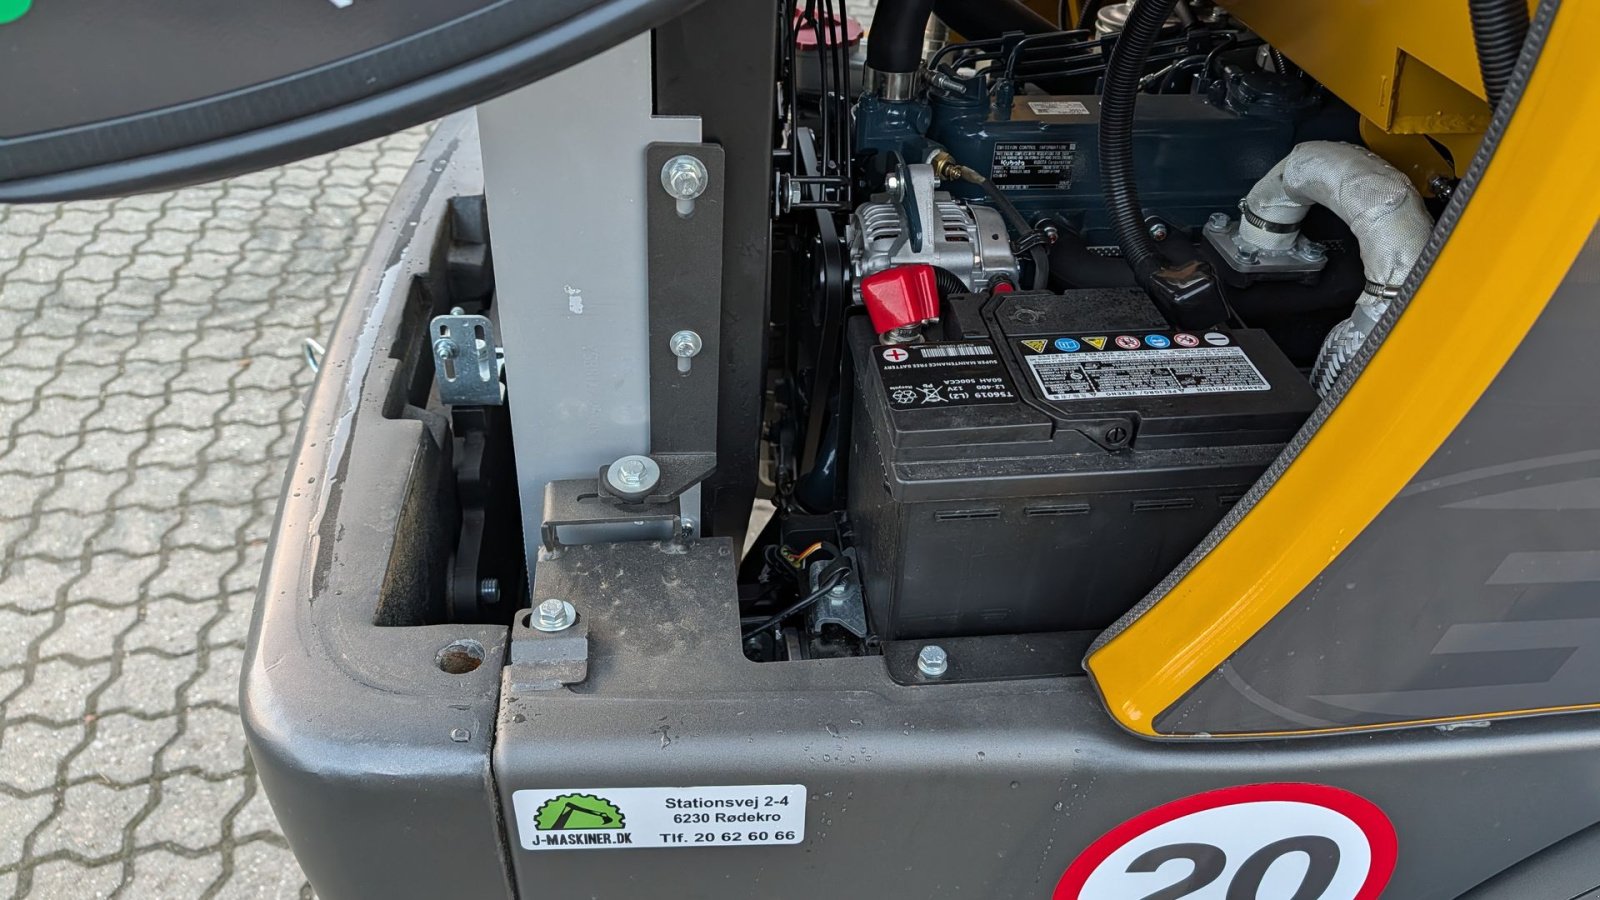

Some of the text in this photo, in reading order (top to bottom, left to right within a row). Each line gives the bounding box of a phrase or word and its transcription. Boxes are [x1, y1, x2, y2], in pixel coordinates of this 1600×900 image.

[665, 796, 790, 810] Stationsvej 2-4
[673, 812, 782, 824] 6230 Rødekro
[532, 832, 632, 846] J-MASKINER.DK
[660, 830, 796, 844] Tlf. 20 62 60 66
[1125, 834, 1341, 900] 20
